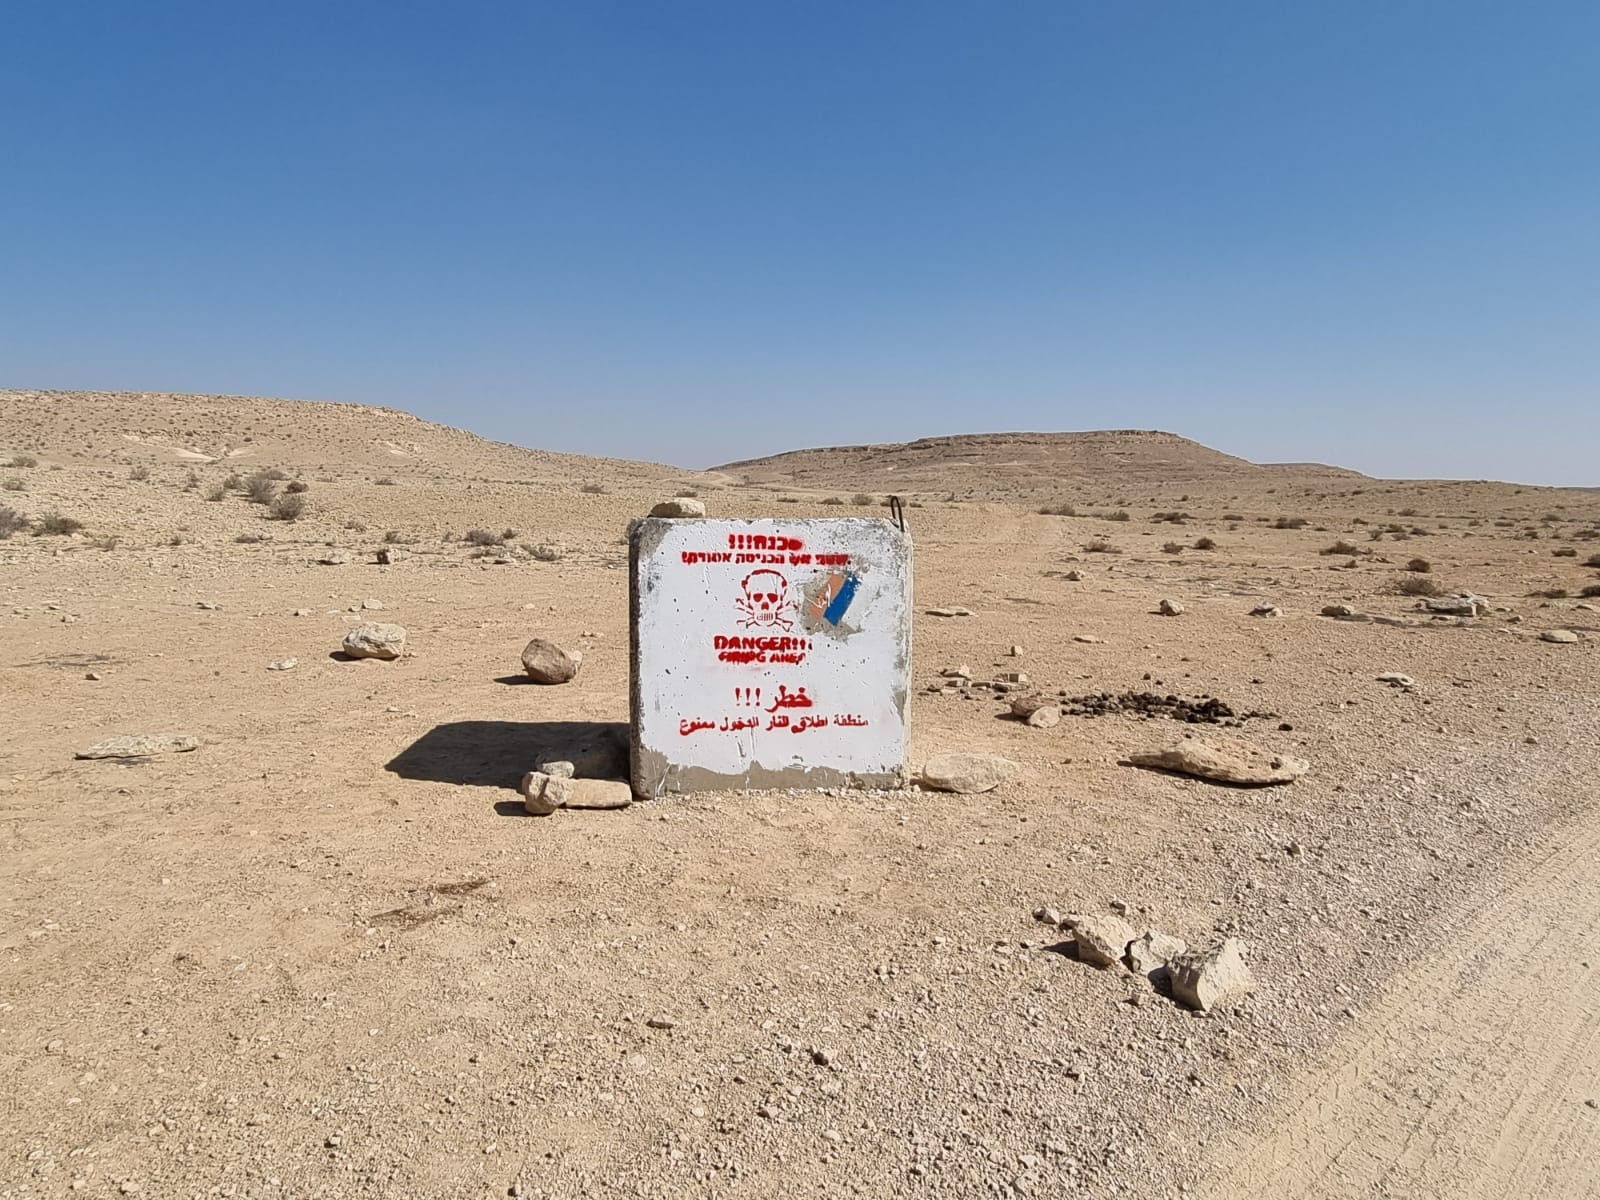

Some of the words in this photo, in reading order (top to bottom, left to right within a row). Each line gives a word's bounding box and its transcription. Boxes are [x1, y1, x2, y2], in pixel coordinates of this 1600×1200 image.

[735, 553, 786, 565] הכניסה
[764, 685, 813, 713] خطر
[679, 717, 715, 736] ممنوع
